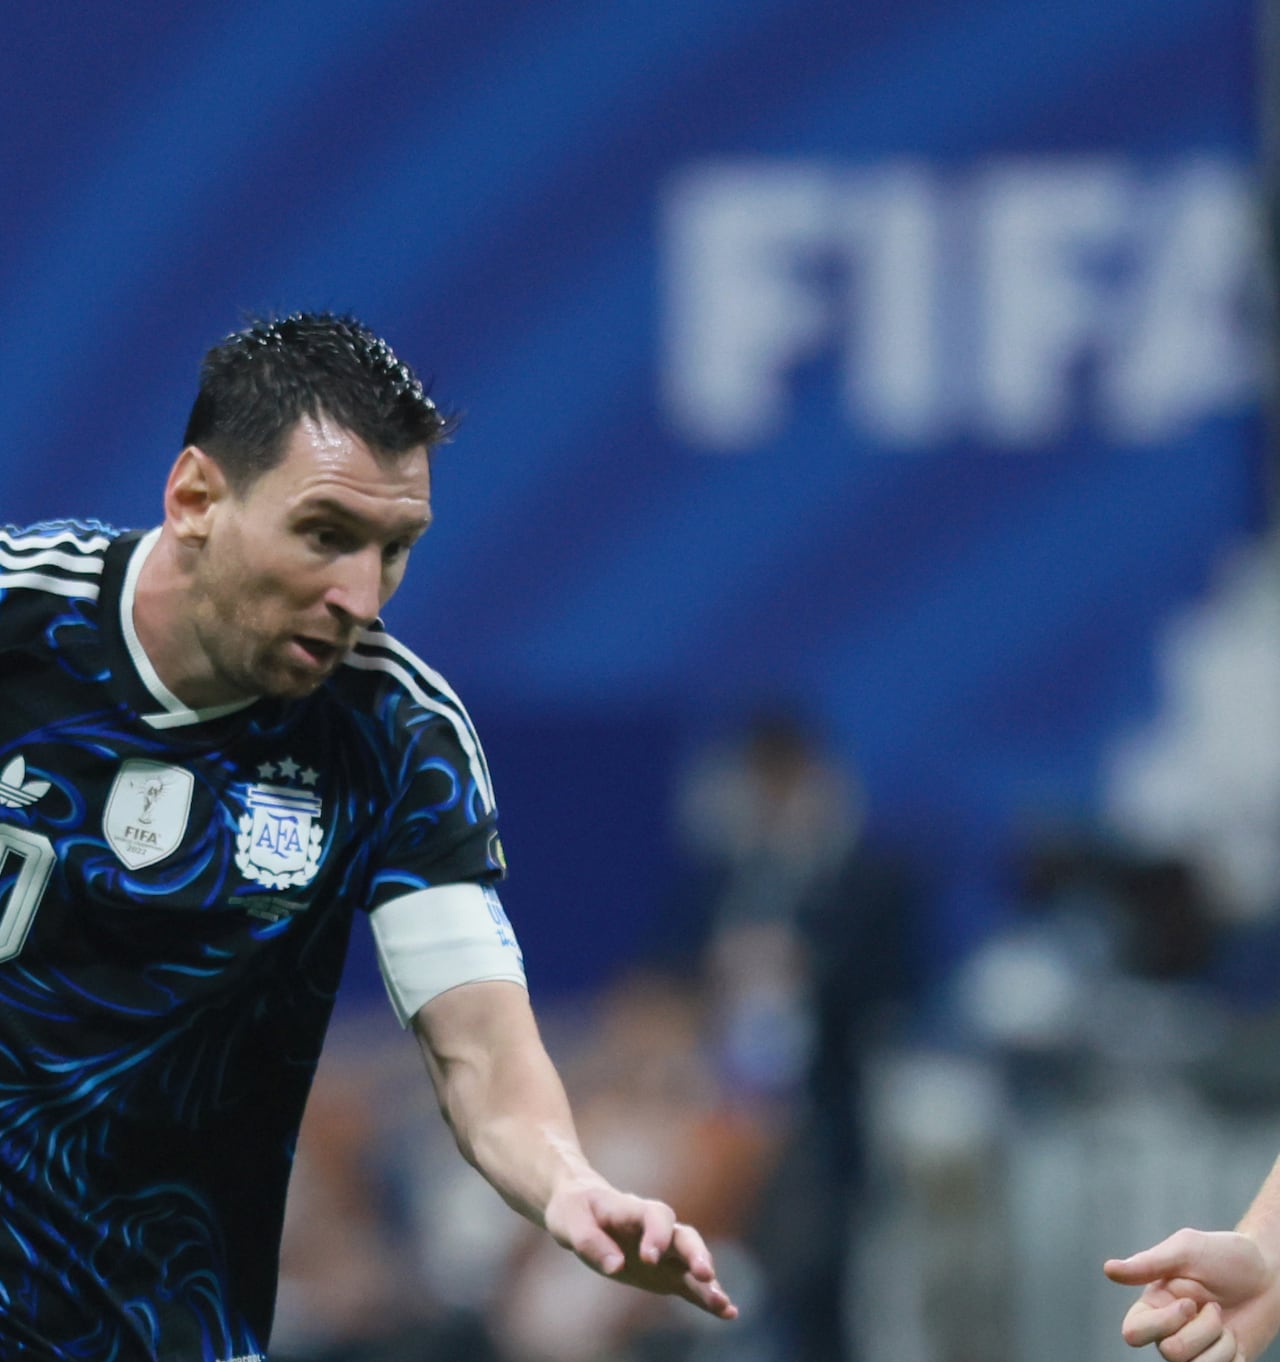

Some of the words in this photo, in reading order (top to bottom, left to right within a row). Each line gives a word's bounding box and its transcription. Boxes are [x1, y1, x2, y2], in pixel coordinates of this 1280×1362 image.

[663, 156, 1266, 447] FIFA
[124, 826, 158, 845] FIFA
[256, 811, 303, 859] AFA
